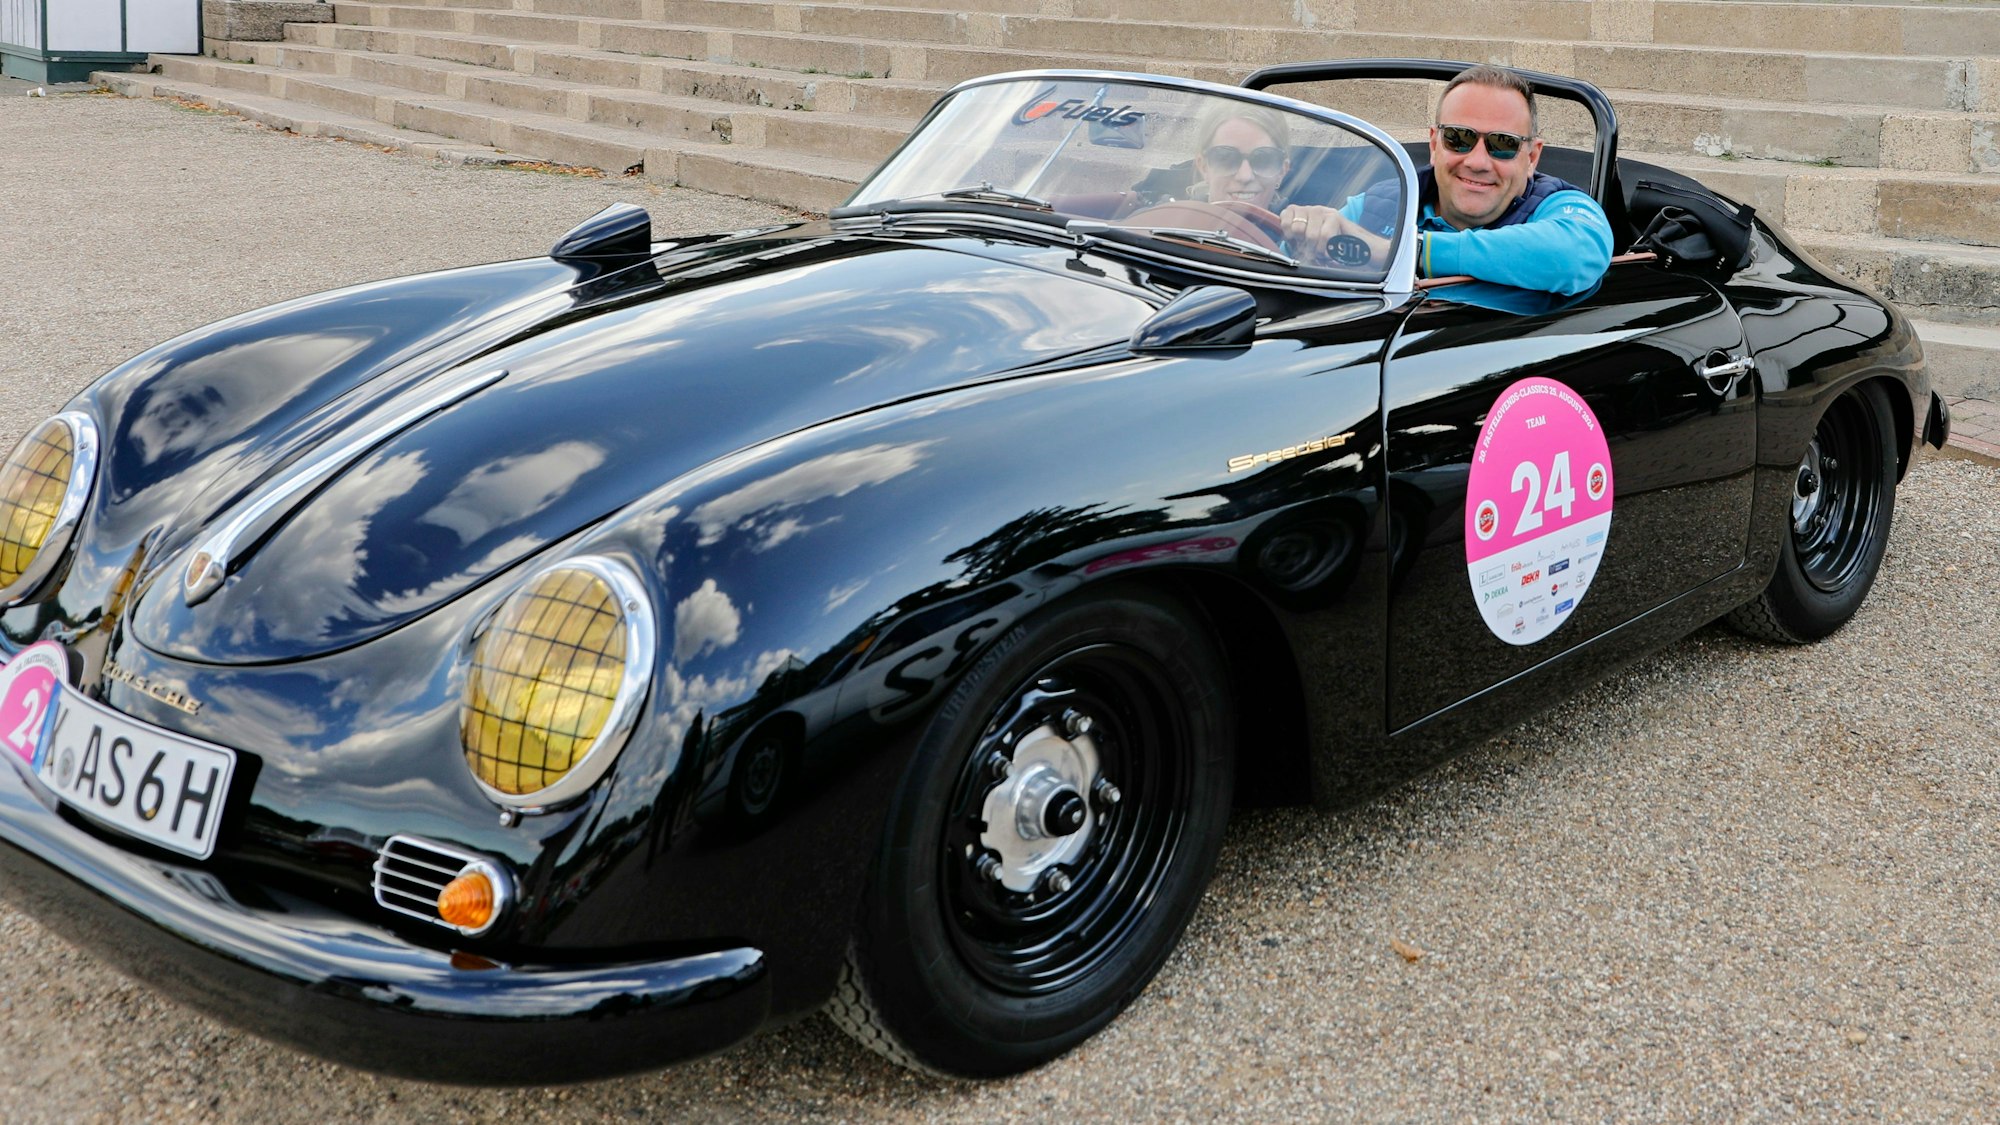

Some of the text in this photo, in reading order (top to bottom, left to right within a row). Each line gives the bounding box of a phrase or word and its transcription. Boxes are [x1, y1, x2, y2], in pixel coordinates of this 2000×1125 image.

[1046, 98, 1146, 127] Fuels
[1337, 241, 1361, 259] 911
[1478, 450, 1487, 464] 20.
[1548, 386, 1558, 397] 25.
[1558, 391, 1583, 414] AUGUST
[1581, 411, 1595, 431] 2024
[1525, 415, 1546, 429] TEAM
[1227, 431, 1356, 473] Speedster
[1510, 450, 1575, 537] 24
[1491, 586, 1508, 600] DEKRA
[1521, 569, 1540, 586] DEKA
[102, 660, 204, 716] PORSCHE
[941, 624, 1029, 722] VREDESTEIN
